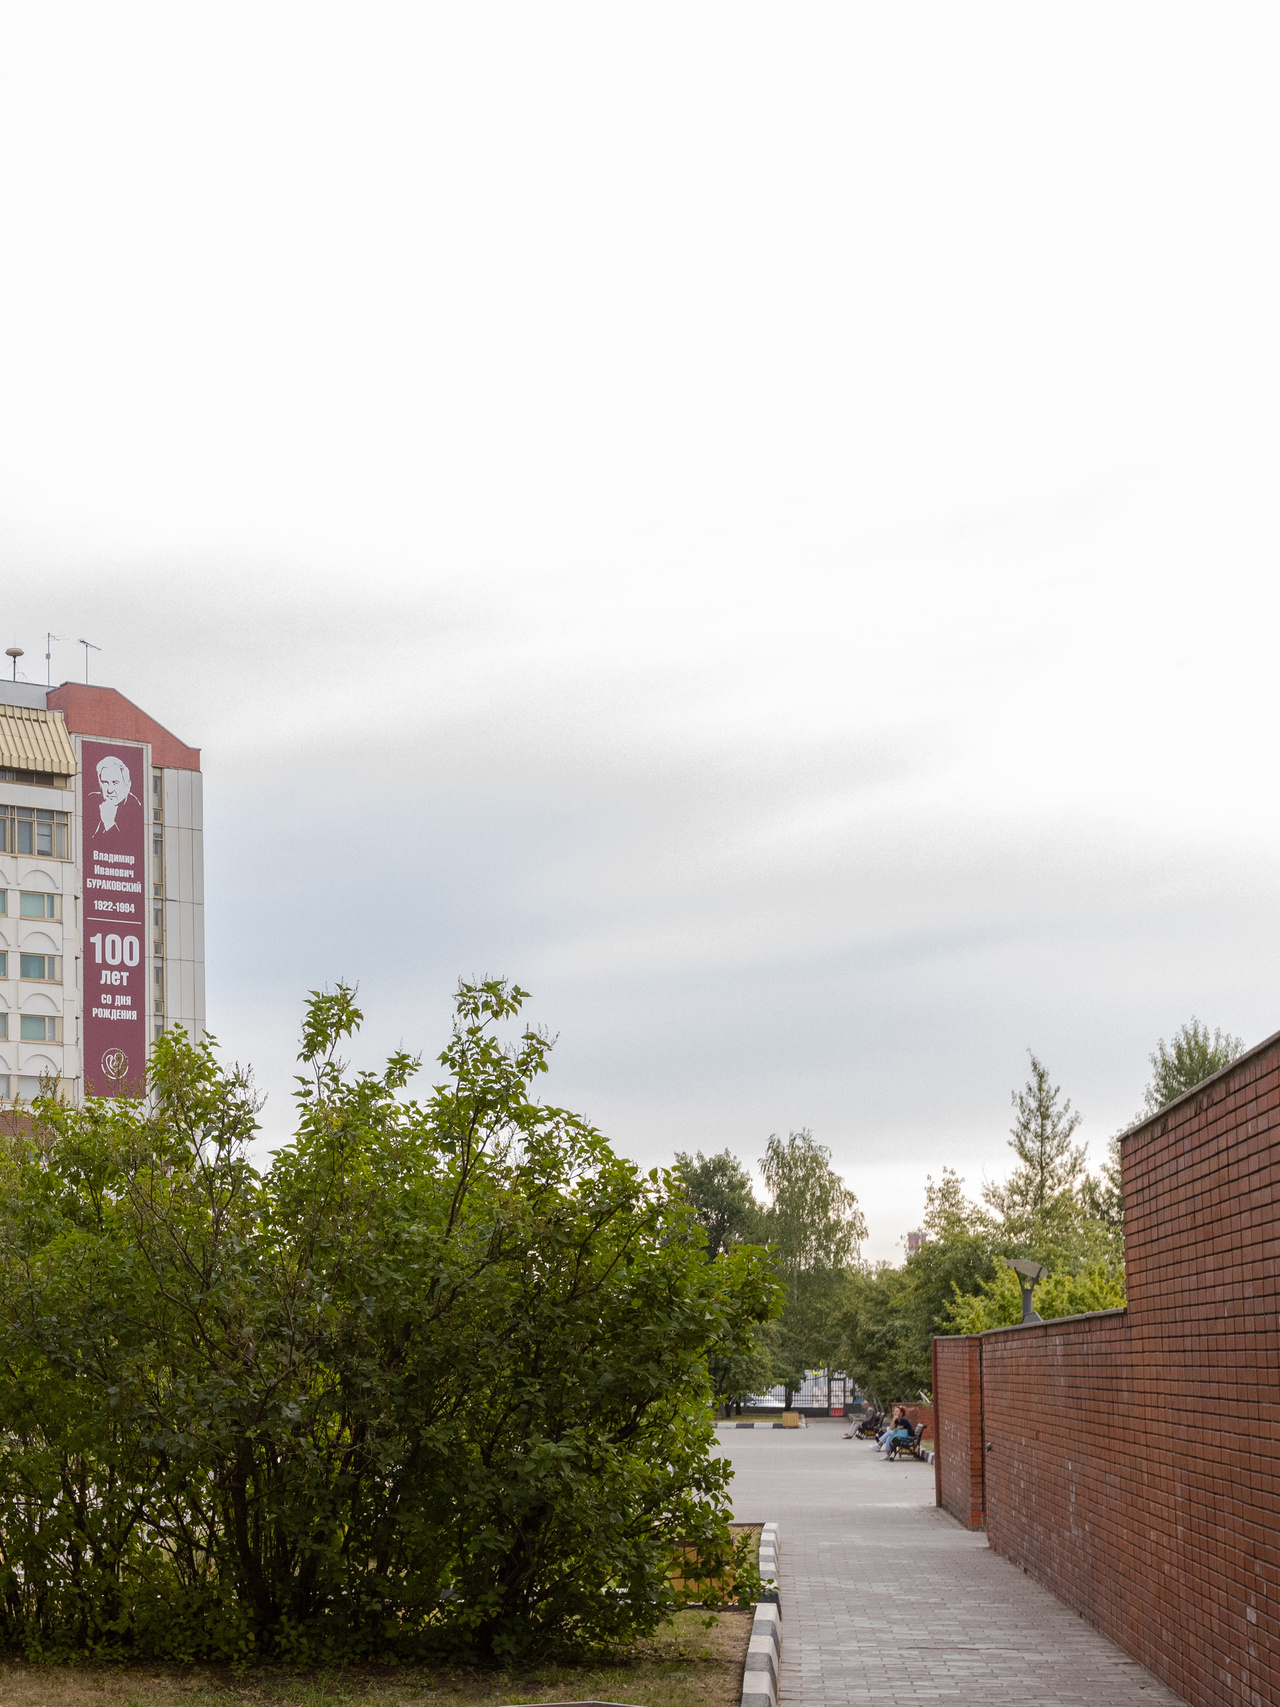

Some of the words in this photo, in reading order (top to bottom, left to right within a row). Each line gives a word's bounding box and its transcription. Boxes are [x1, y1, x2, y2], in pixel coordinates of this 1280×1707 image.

[93, 850, 135, 865] Владимир
[94, 865, 134, 878] Иванович
[87, 878, 141, 892] БУРАКОВСКИЙ
[93, 900, 135, 913] 1922-1994
[89, 933, 140, 967] 100
[100, 970, 129, 986] лет
[114, 995, 131, 1006] ДНЯ
[92, 1008, 137, 1020] РОЖДЕНИЯ
